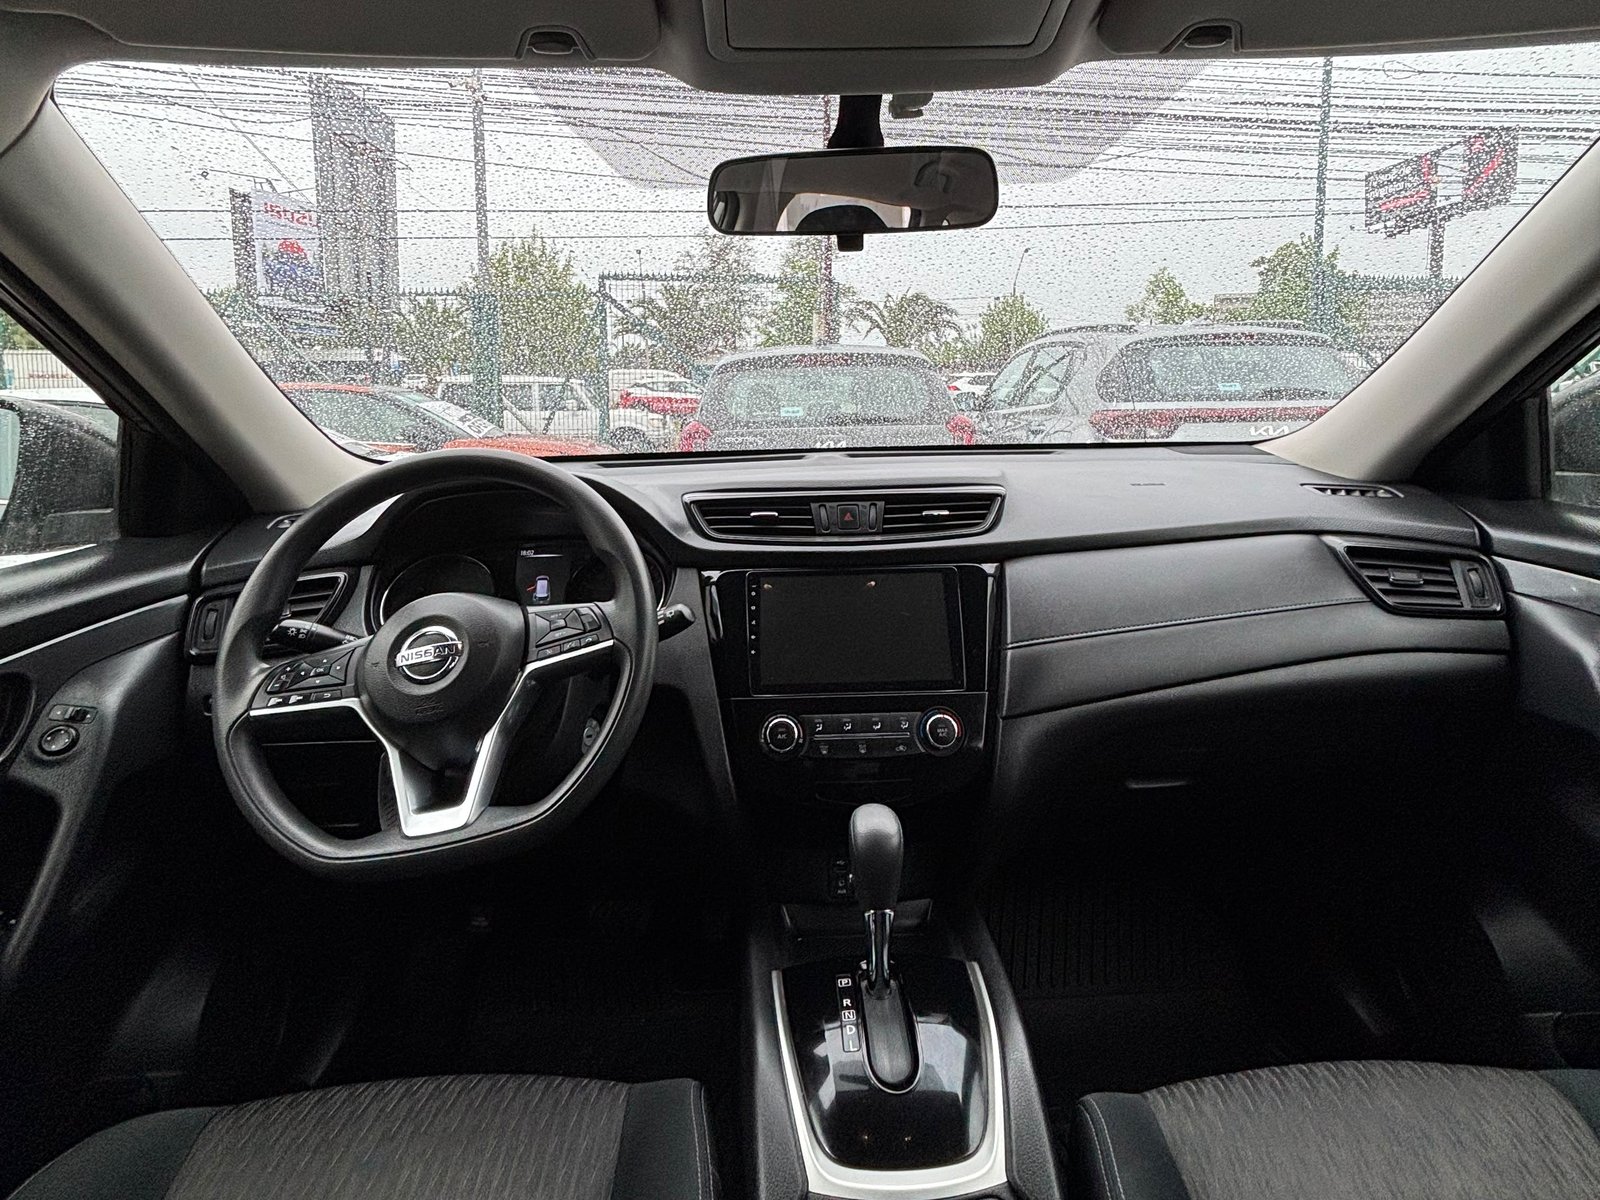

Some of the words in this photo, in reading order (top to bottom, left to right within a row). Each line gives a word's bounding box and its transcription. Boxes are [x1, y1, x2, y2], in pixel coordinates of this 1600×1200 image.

[1249, 425, 1289, 436] KIA
[400, 645, 456, 663] NISSAN
[846, 1025, 855, 1034] D
[849, 1040, 857, 1051] L
